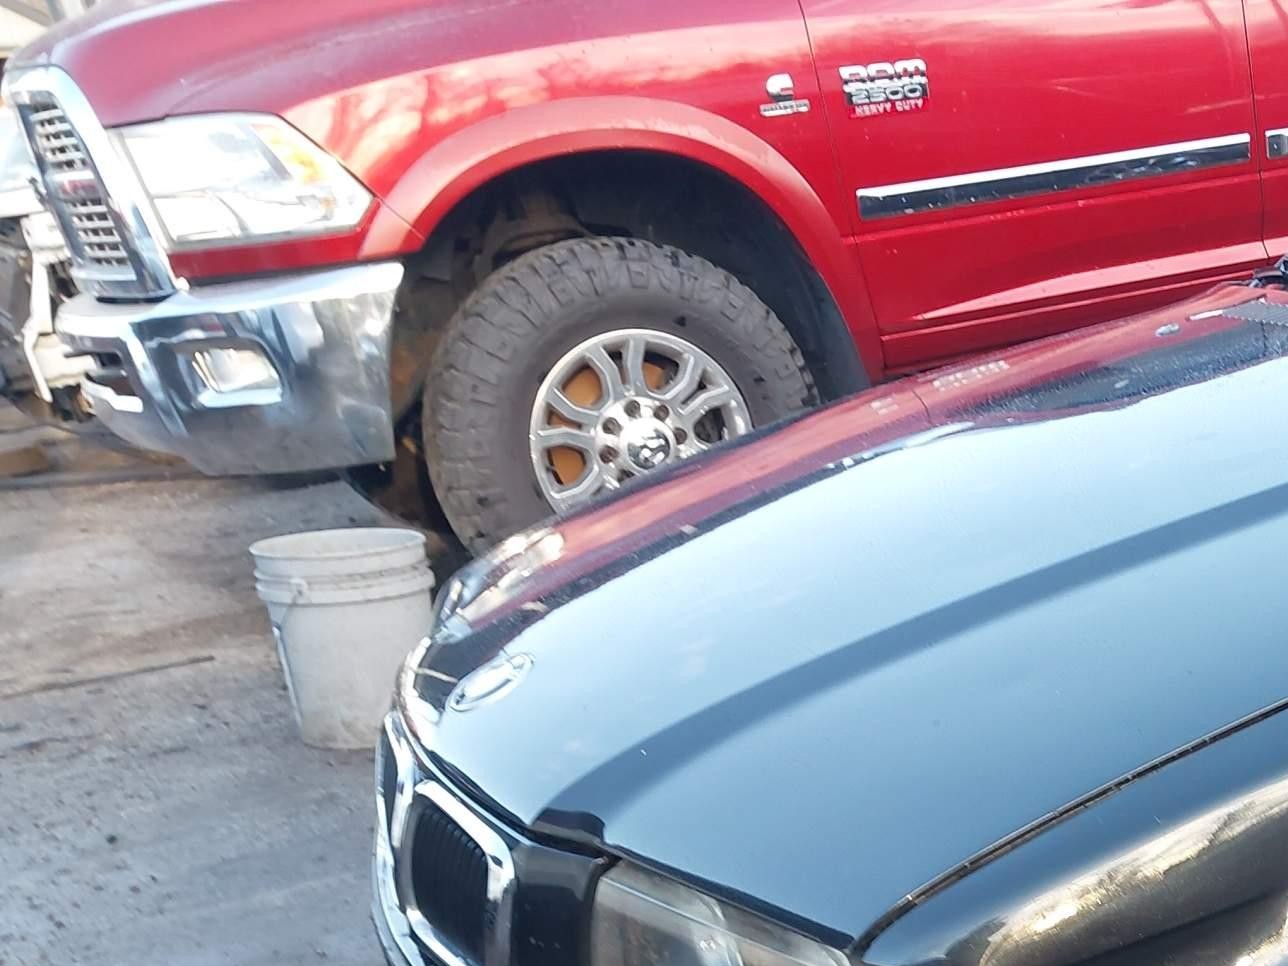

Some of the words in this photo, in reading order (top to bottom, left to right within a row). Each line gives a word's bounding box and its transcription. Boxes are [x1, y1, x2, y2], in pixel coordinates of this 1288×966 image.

[839, 58, 927, 84] RAM
[851, 83, 923, 105] 2500
[855, 102, 892, 117] HEAVY
[895, 98, 924, 112] DUTY
